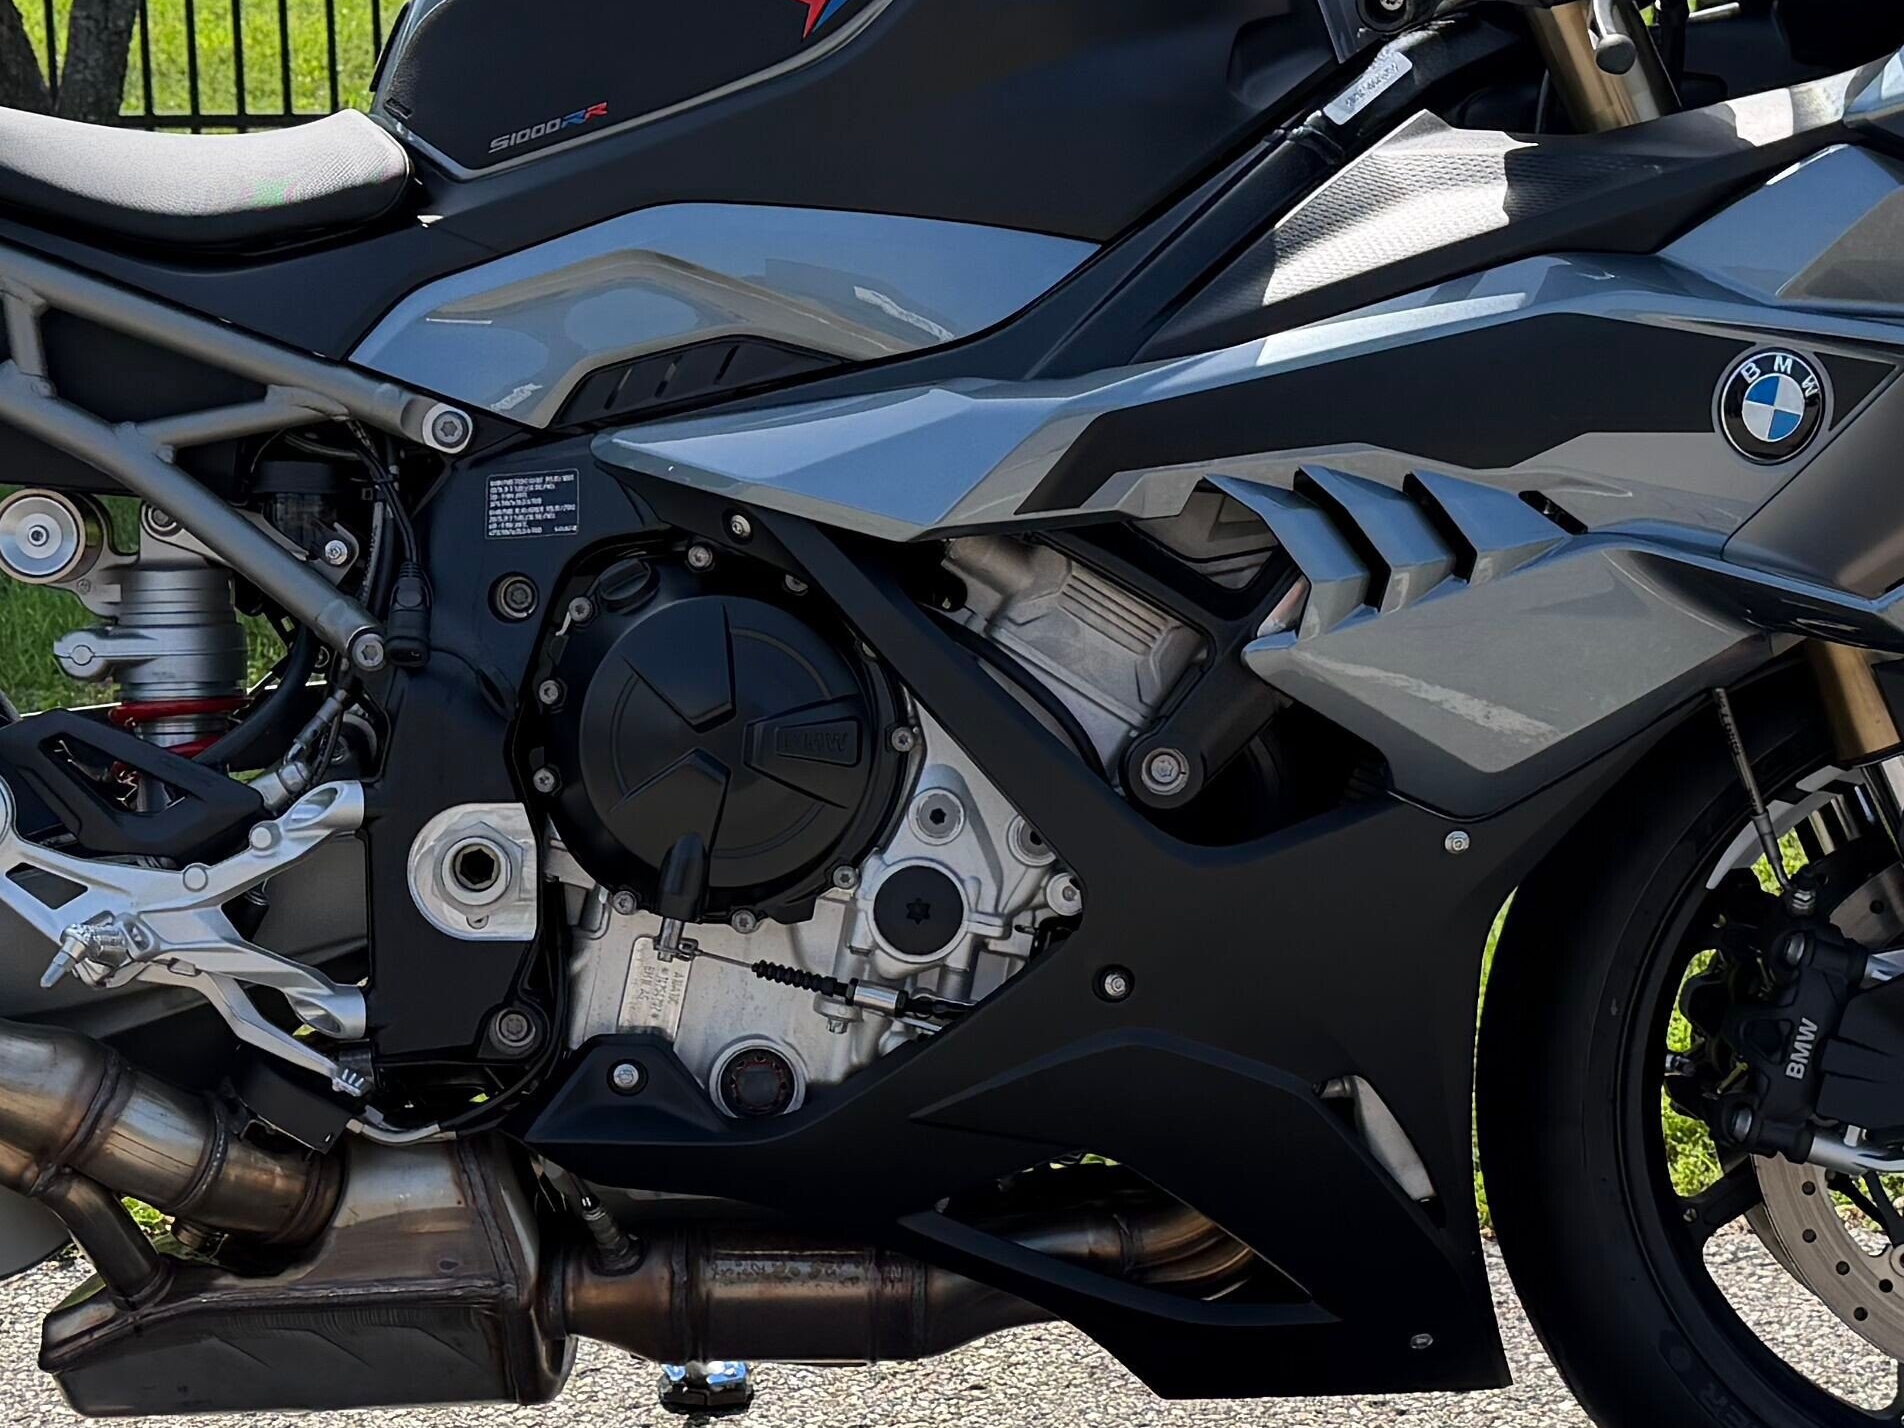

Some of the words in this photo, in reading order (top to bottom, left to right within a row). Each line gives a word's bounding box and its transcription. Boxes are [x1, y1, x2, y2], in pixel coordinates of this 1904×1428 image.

[488, 101, 609, 154] S1000RR
[1740, 355, 1820, 397] BMW
[1785, 1017, 1821, 1081] BMW
